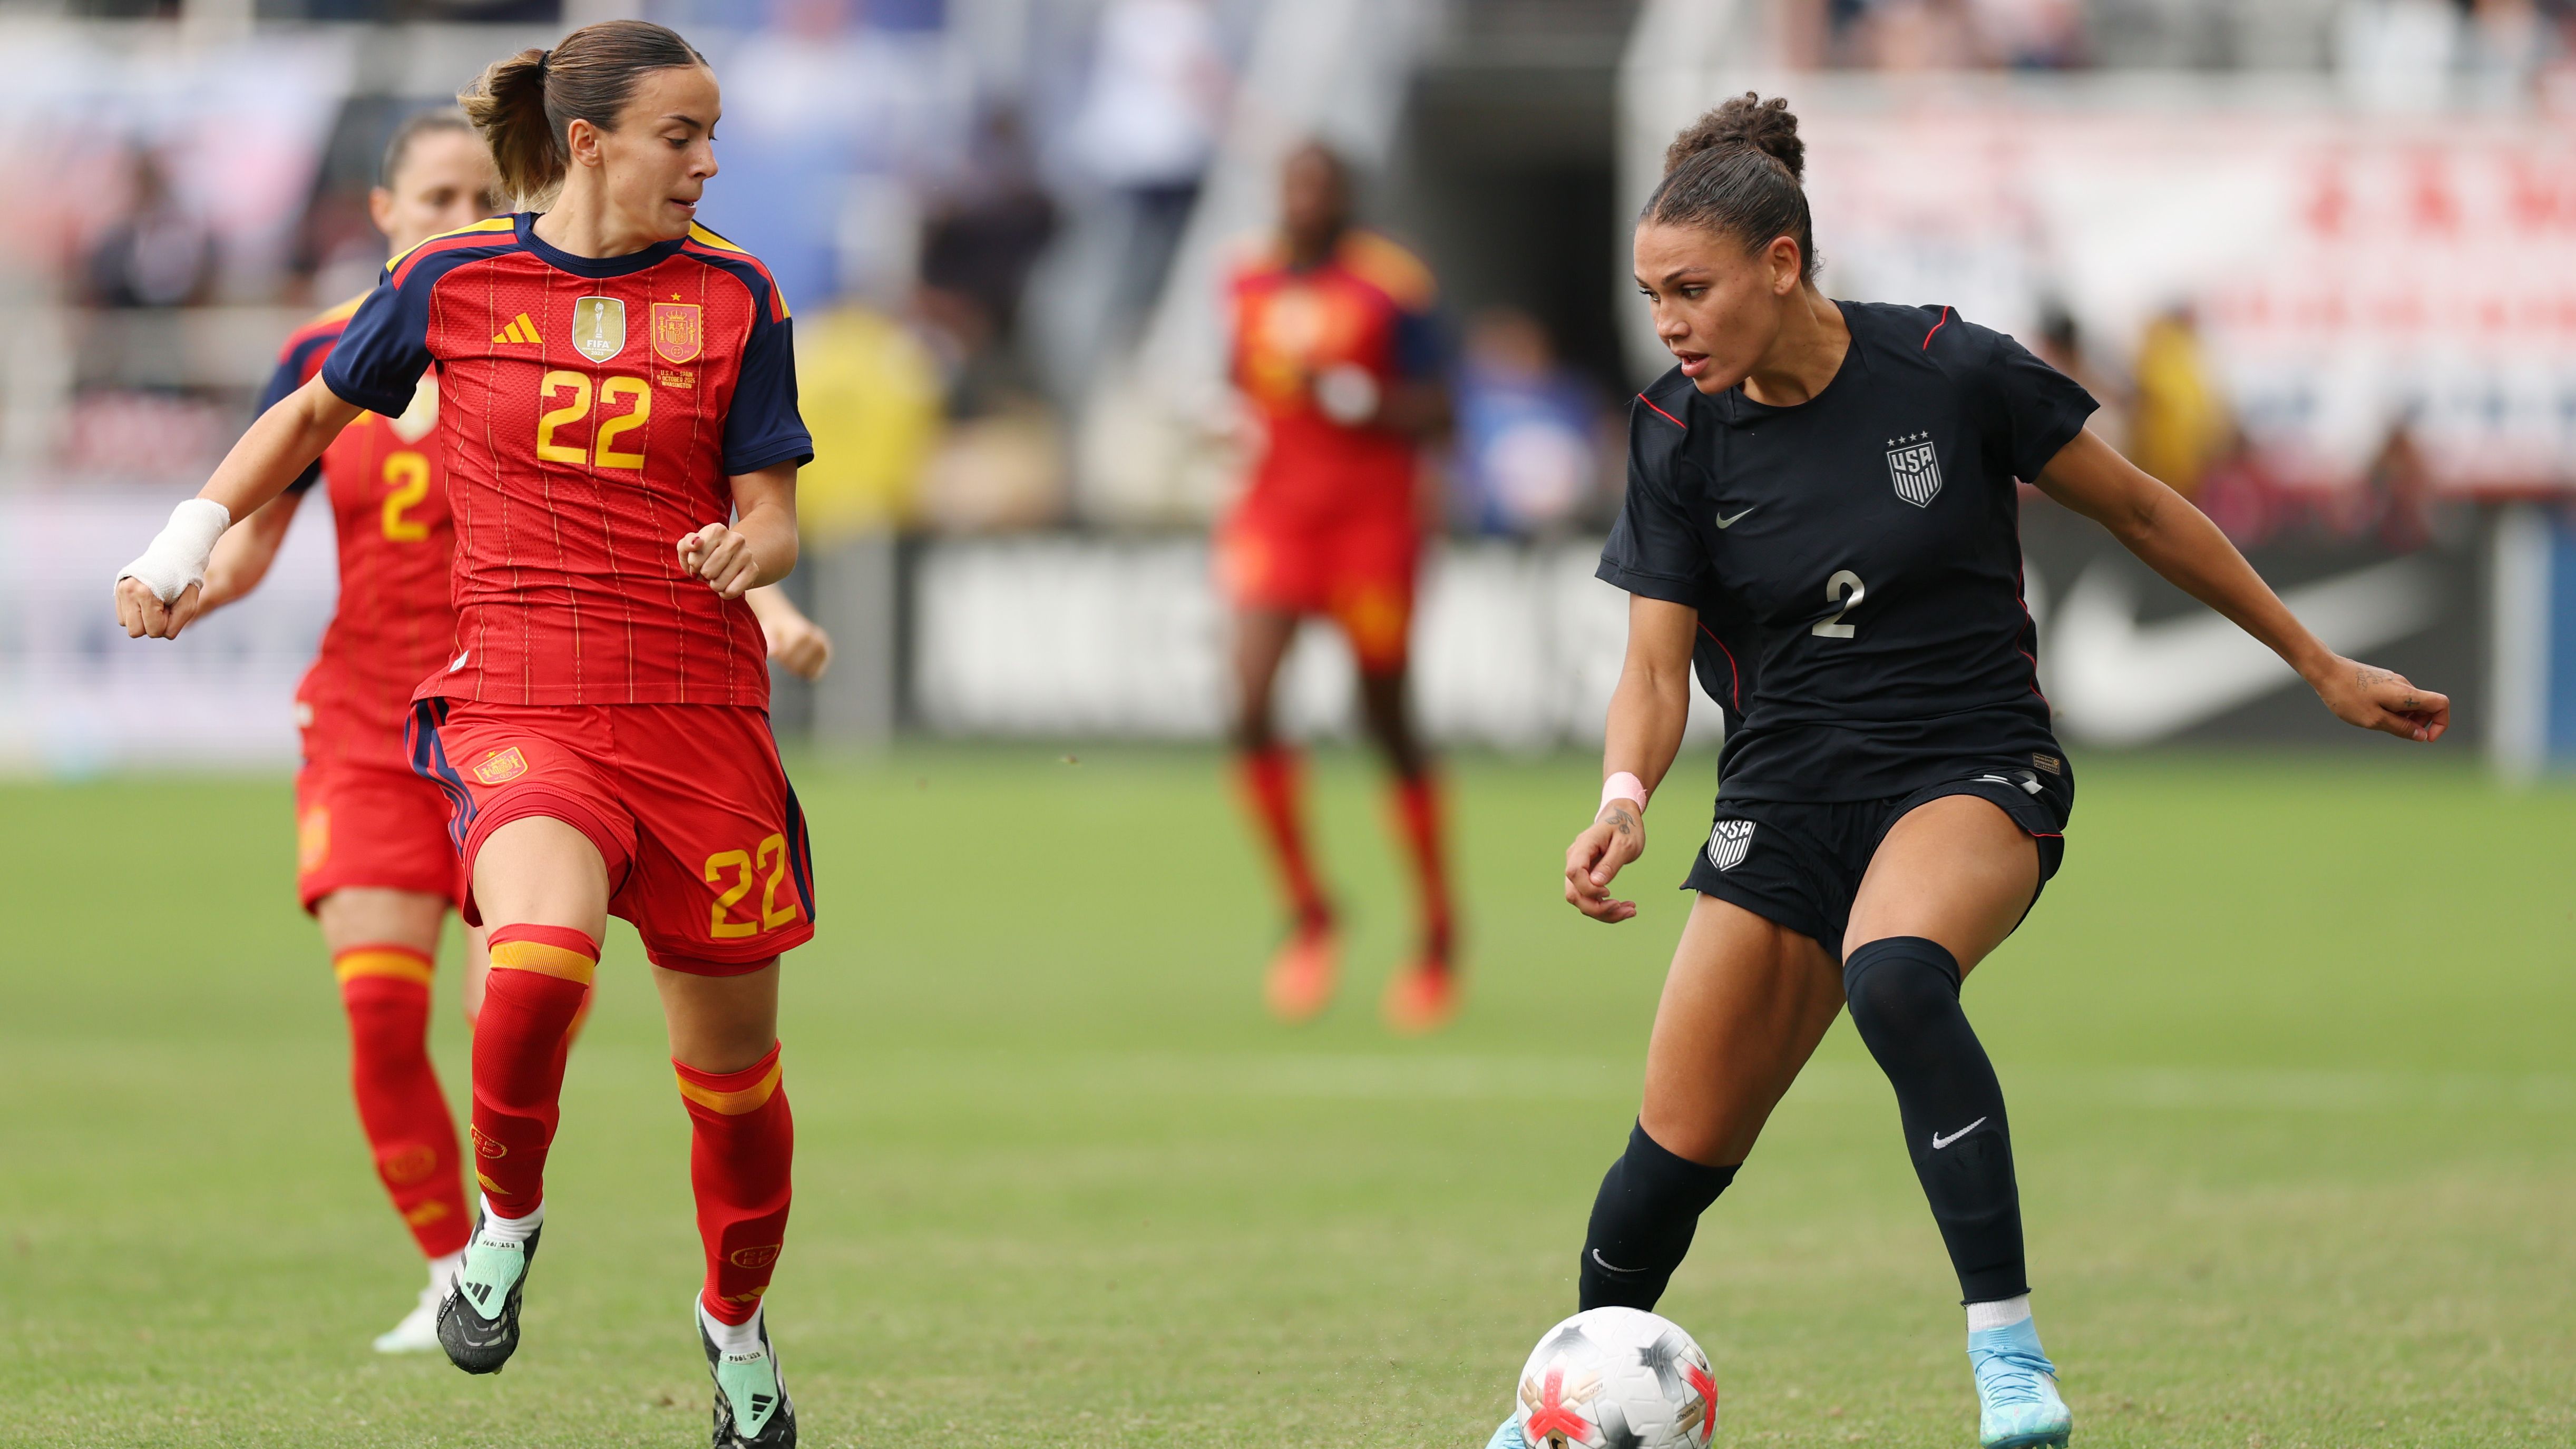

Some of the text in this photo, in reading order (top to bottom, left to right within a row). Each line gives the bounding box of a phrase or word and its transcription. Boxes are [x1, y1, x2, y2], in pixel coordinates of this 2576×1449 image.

[587, 340, 609, 348] FIFA
[537, 370, 651, 469] 22
[1891, 447, 1933, 473] USA
[382, 451, 430, 542] 2
[1811, 570, 1865, 639] 2
[1719, 820, 1753, 839] USA
[705, 833, 797, 938] 22
